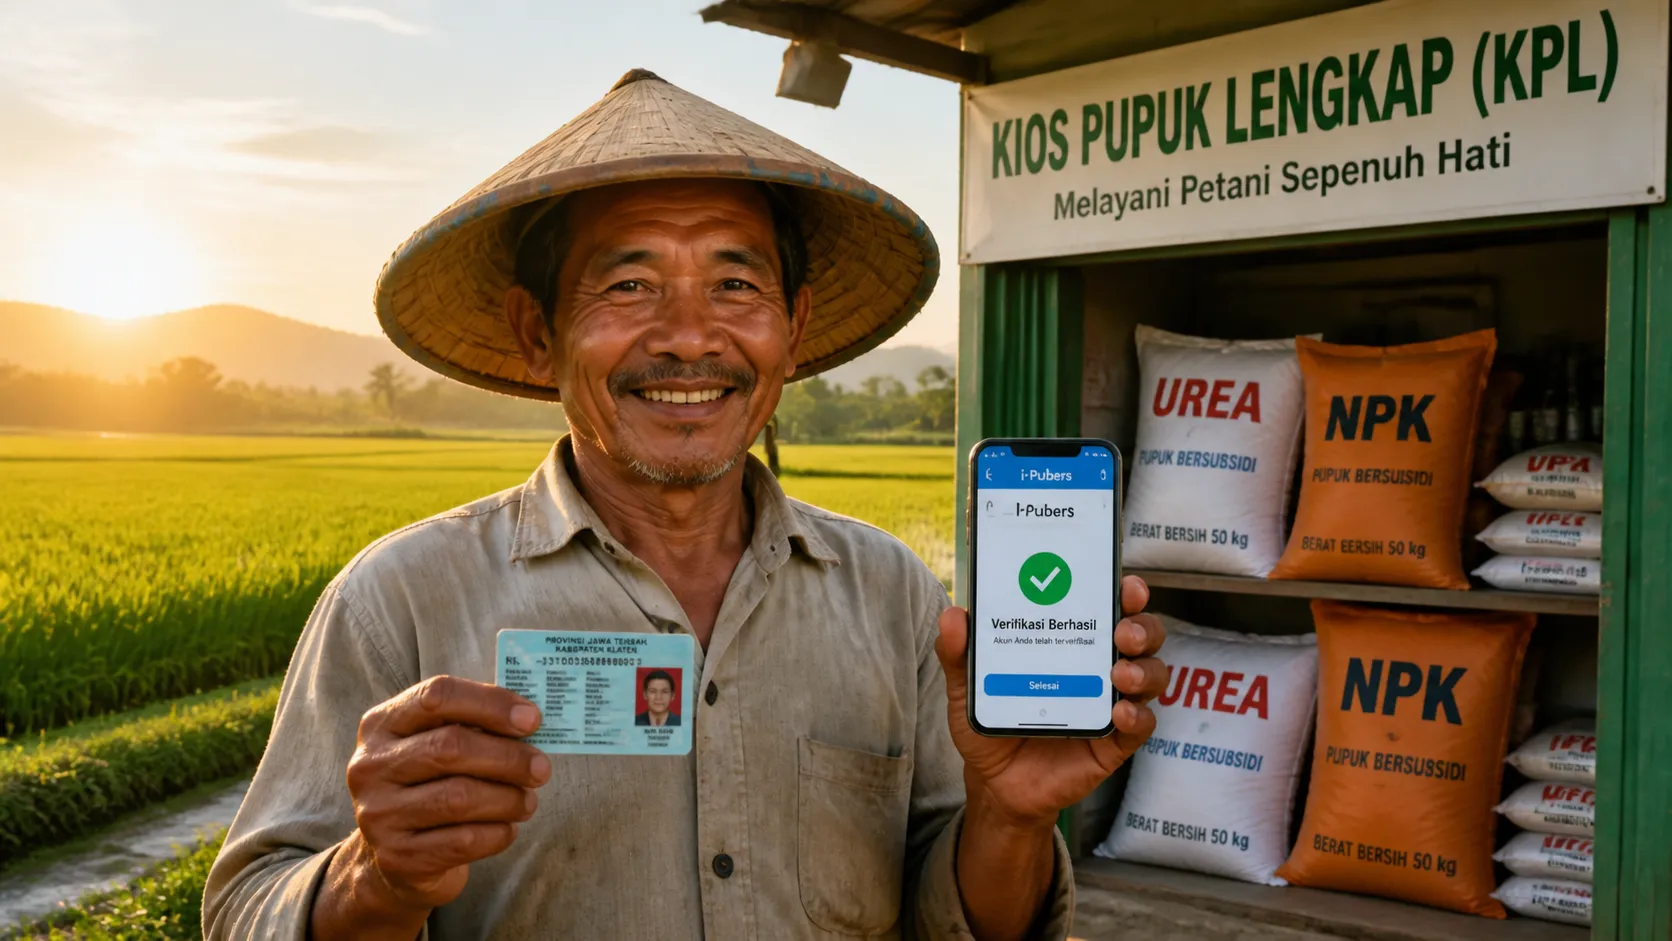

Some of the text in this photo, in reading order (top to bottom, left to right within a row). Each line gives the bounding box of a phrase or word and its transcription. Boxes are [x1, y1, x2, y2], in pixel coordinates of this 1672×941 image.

[992, 9, 1619, 179] KIOS PUPUK LENGKAP (KPL)
[1053, 132, 1511, 221] Melayani Petani Sepenuh Hati
[1152, 377, 1261, 424] UREA
[1324, 394, 1436, 443] NPK
[1130, 522, 1248, 550] BERAT BERSIH 50 kg
[1301, 536, 1336, 552] BERAT
[1388, 540, 1405, 556] 50
[1408, 540, 1427, 559] kg
[991, 618, 1097, 631] Verifikasi Berhasil
[993, 636, 1012, 645] Akun
[1029, 681, 1060, 690] Selesai
[1158, 665, 1268, 720] UREA
[1340, 657, 1468, 725] NPK
[1182, 743, 1263, 772] BERSUBSIDI
[1326, 745, 1370, 768] PUPUK
[1126, 812, 1249, 851] BERAT BERSIH 50 kg
[1313, 834, 1457, 877] BERAT BERSIH 50 kg
